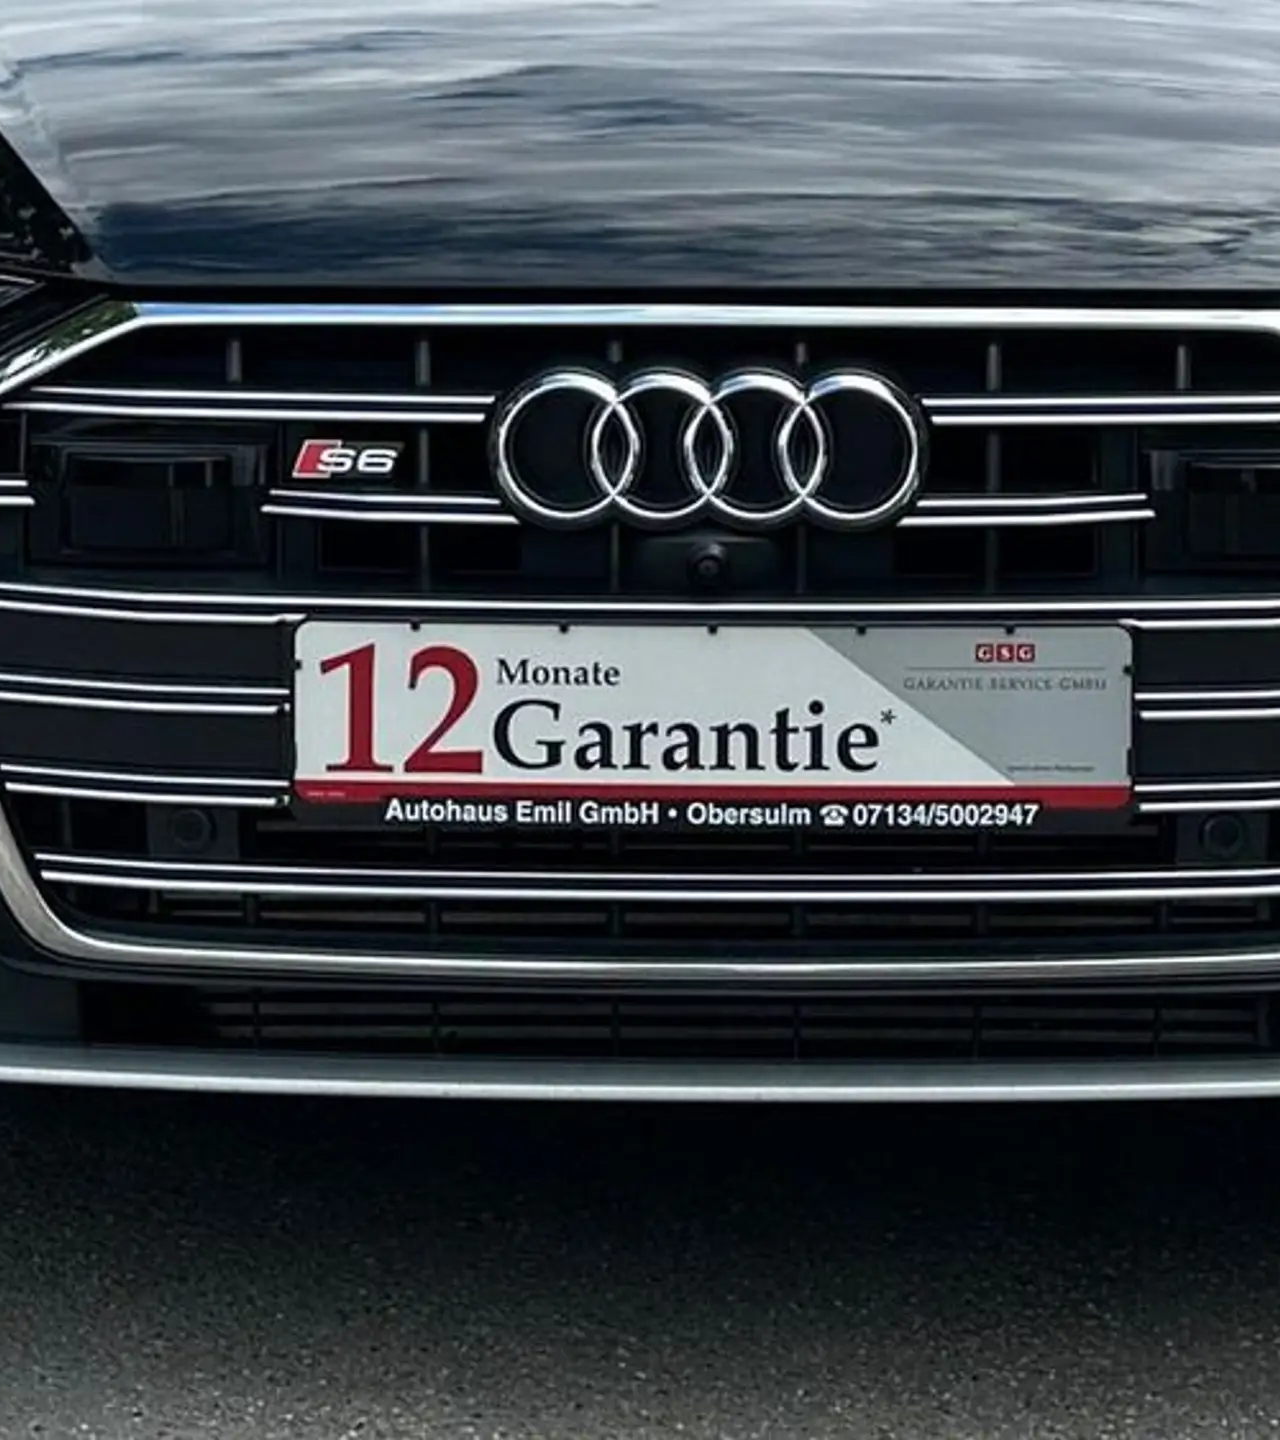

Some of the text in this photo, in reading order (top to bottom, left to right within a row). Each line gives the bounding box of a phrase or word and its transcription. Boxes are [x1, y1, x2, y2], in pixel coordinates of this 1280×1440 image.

[317, 447, 399, 474] S6
[976, 644, 1035, 662] GSG
[320, 643, 621, 774] 12 Monate
[384, 798, 1040, 827] Autohaus Emil GmbH Obersulm 07134/5002947
